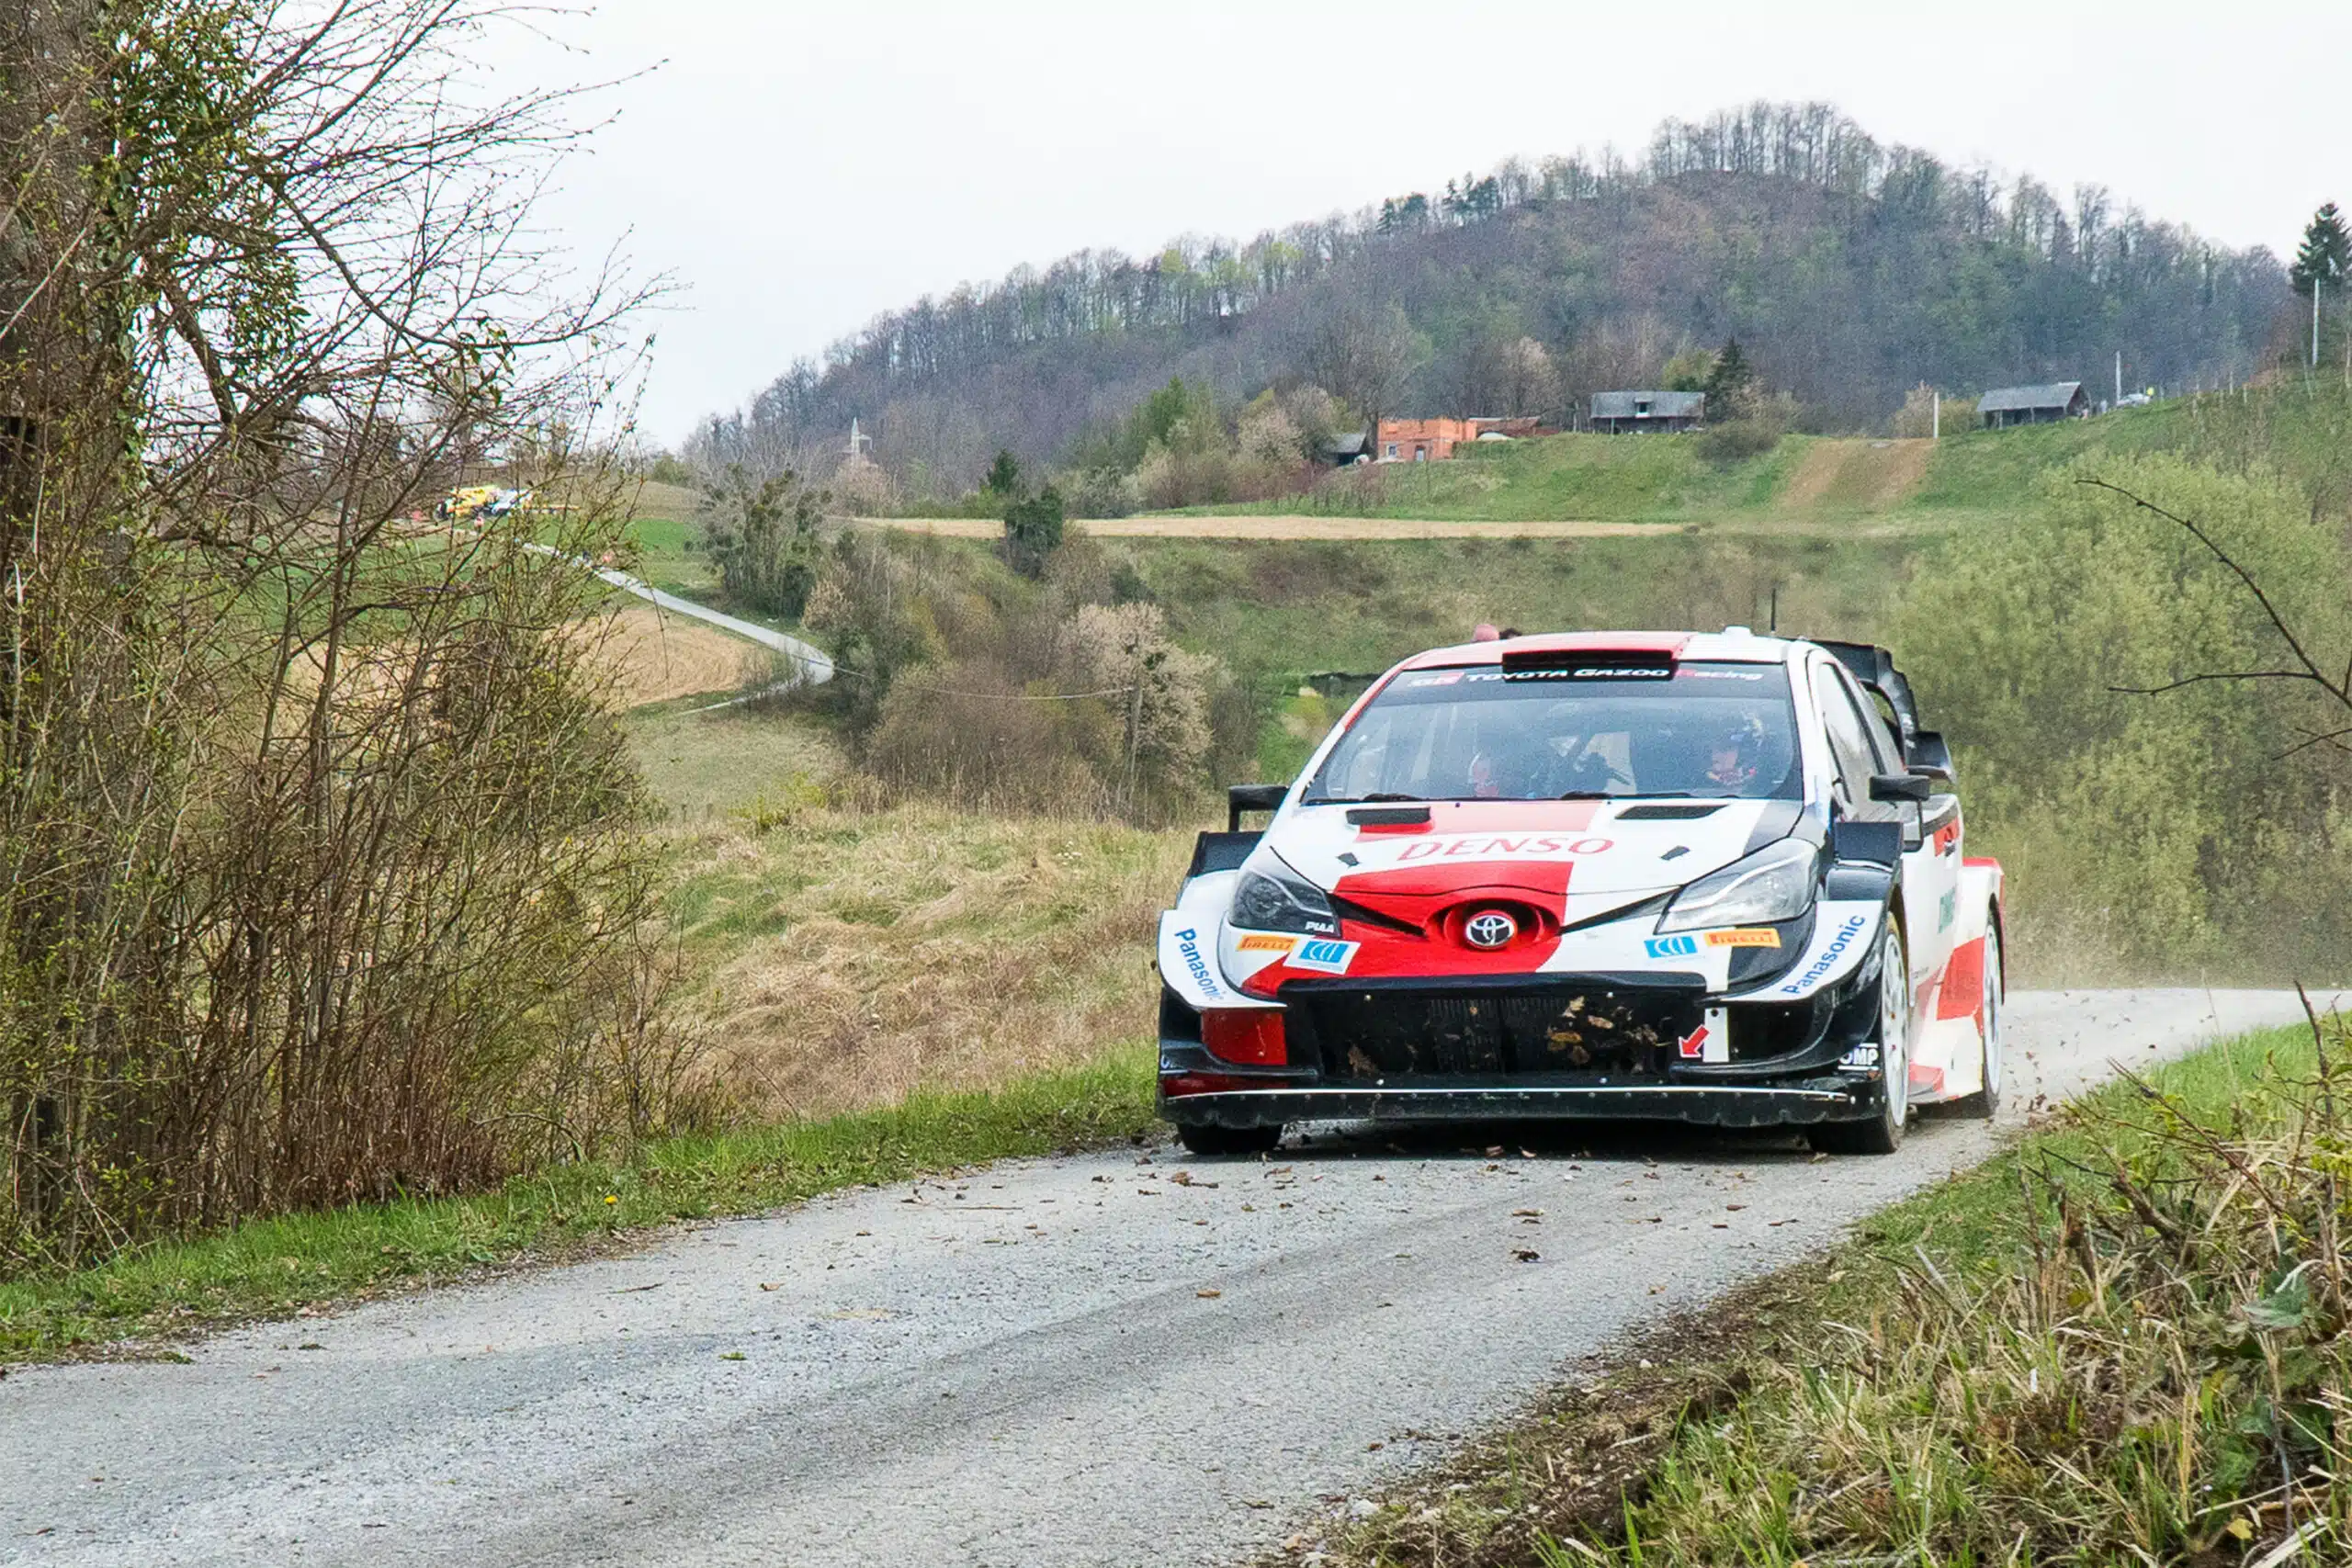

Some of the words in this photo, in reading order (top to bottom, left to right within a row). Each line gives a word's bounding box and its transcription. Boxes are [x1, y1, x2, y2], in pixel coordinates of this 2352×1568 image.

[1466, 669, 1568, 682] TOYOTA
[1573, 668, 1670, 678] GAZOO
[1396, 836, 1615, 862] DENSO
[1305, 920, 1336, 934] PIAA
[1779, 914, 1867, 996] Panasonic
